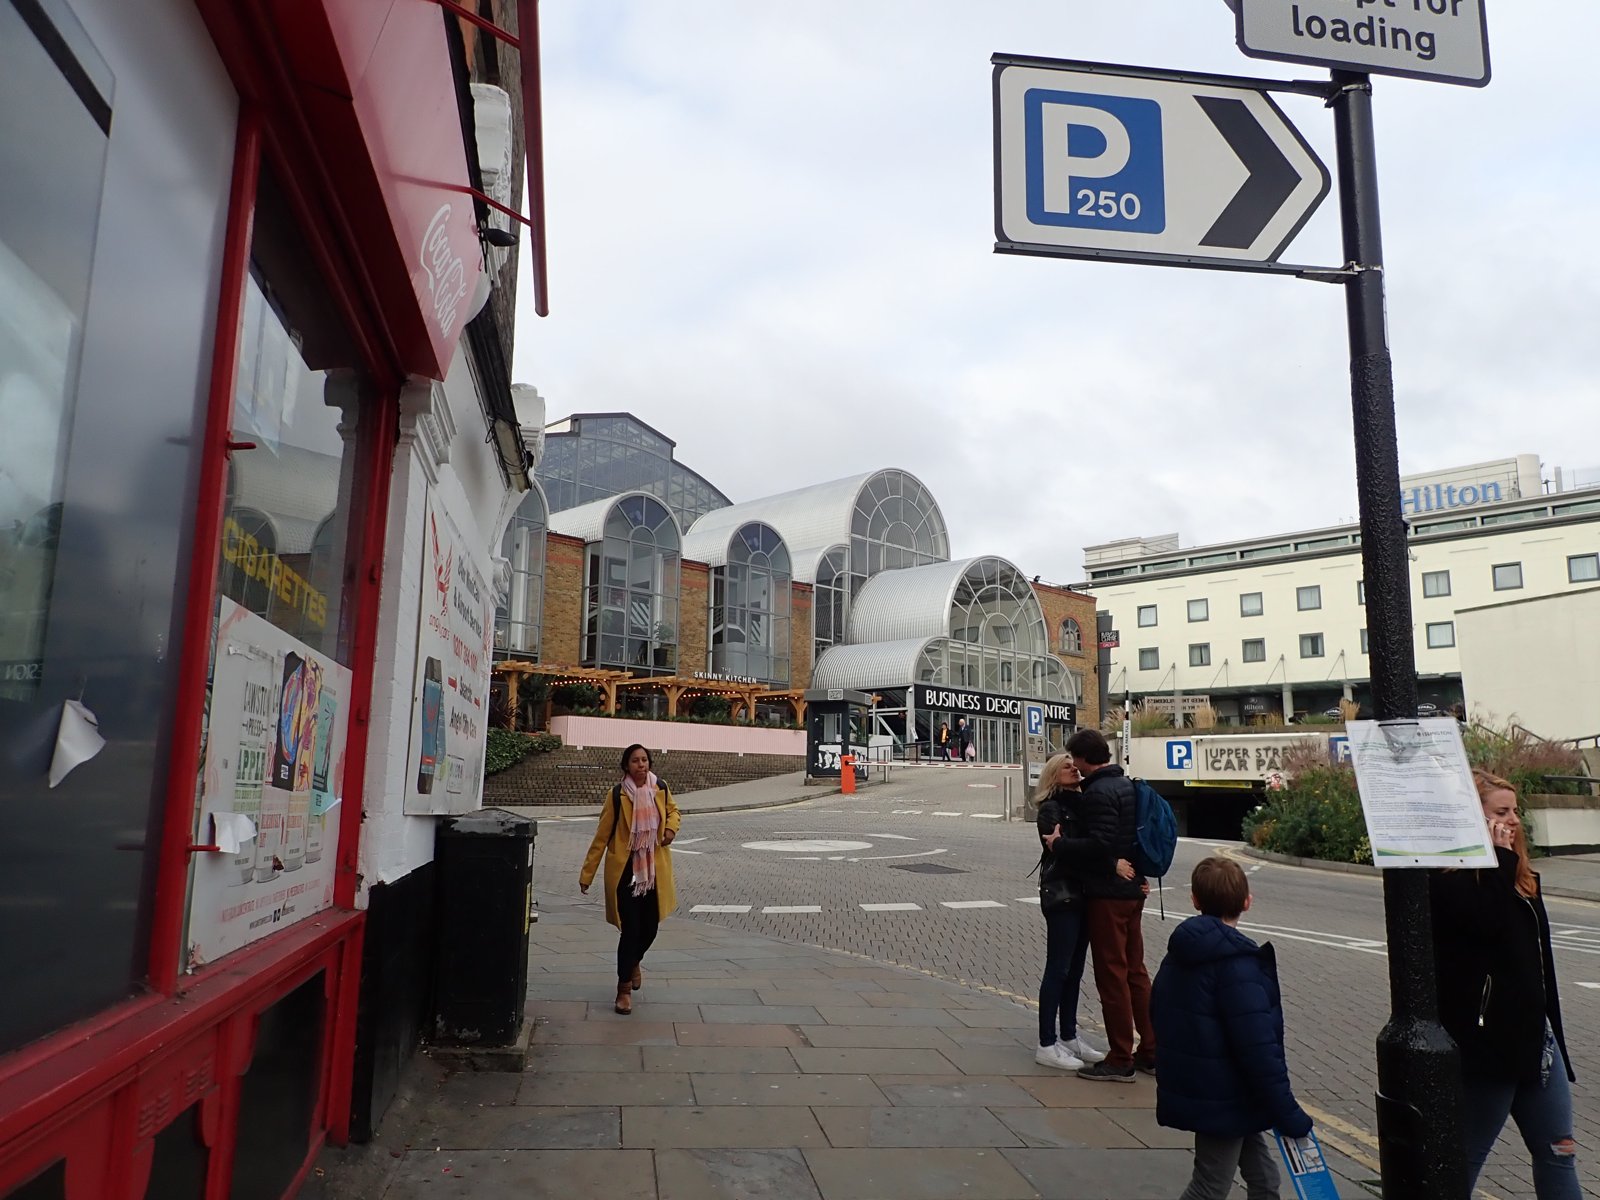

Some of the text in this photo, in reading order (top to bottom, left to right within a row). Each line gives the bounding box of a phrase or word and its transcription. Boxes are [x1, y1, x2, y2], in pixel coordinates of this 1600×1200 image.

[1292, 5, 1436, 60] loading
[1042, 101, 1130, 214] P
[1076, 188, 1141, 221] 250
[1400, 481, 1503, 514] Hilton
[222, 516, 328, 630] CIGARETTES
[694, 671, 757, 684] SKINNY KITCHEN
[925, 689, 981, 711] BUSINESS
[1031, 711, 1039, 730] P
[1172, 744, 1187, 766] P
[1209, 747, 1250, 759] UPPER
[1210, 759, 1248, 771] CAR
